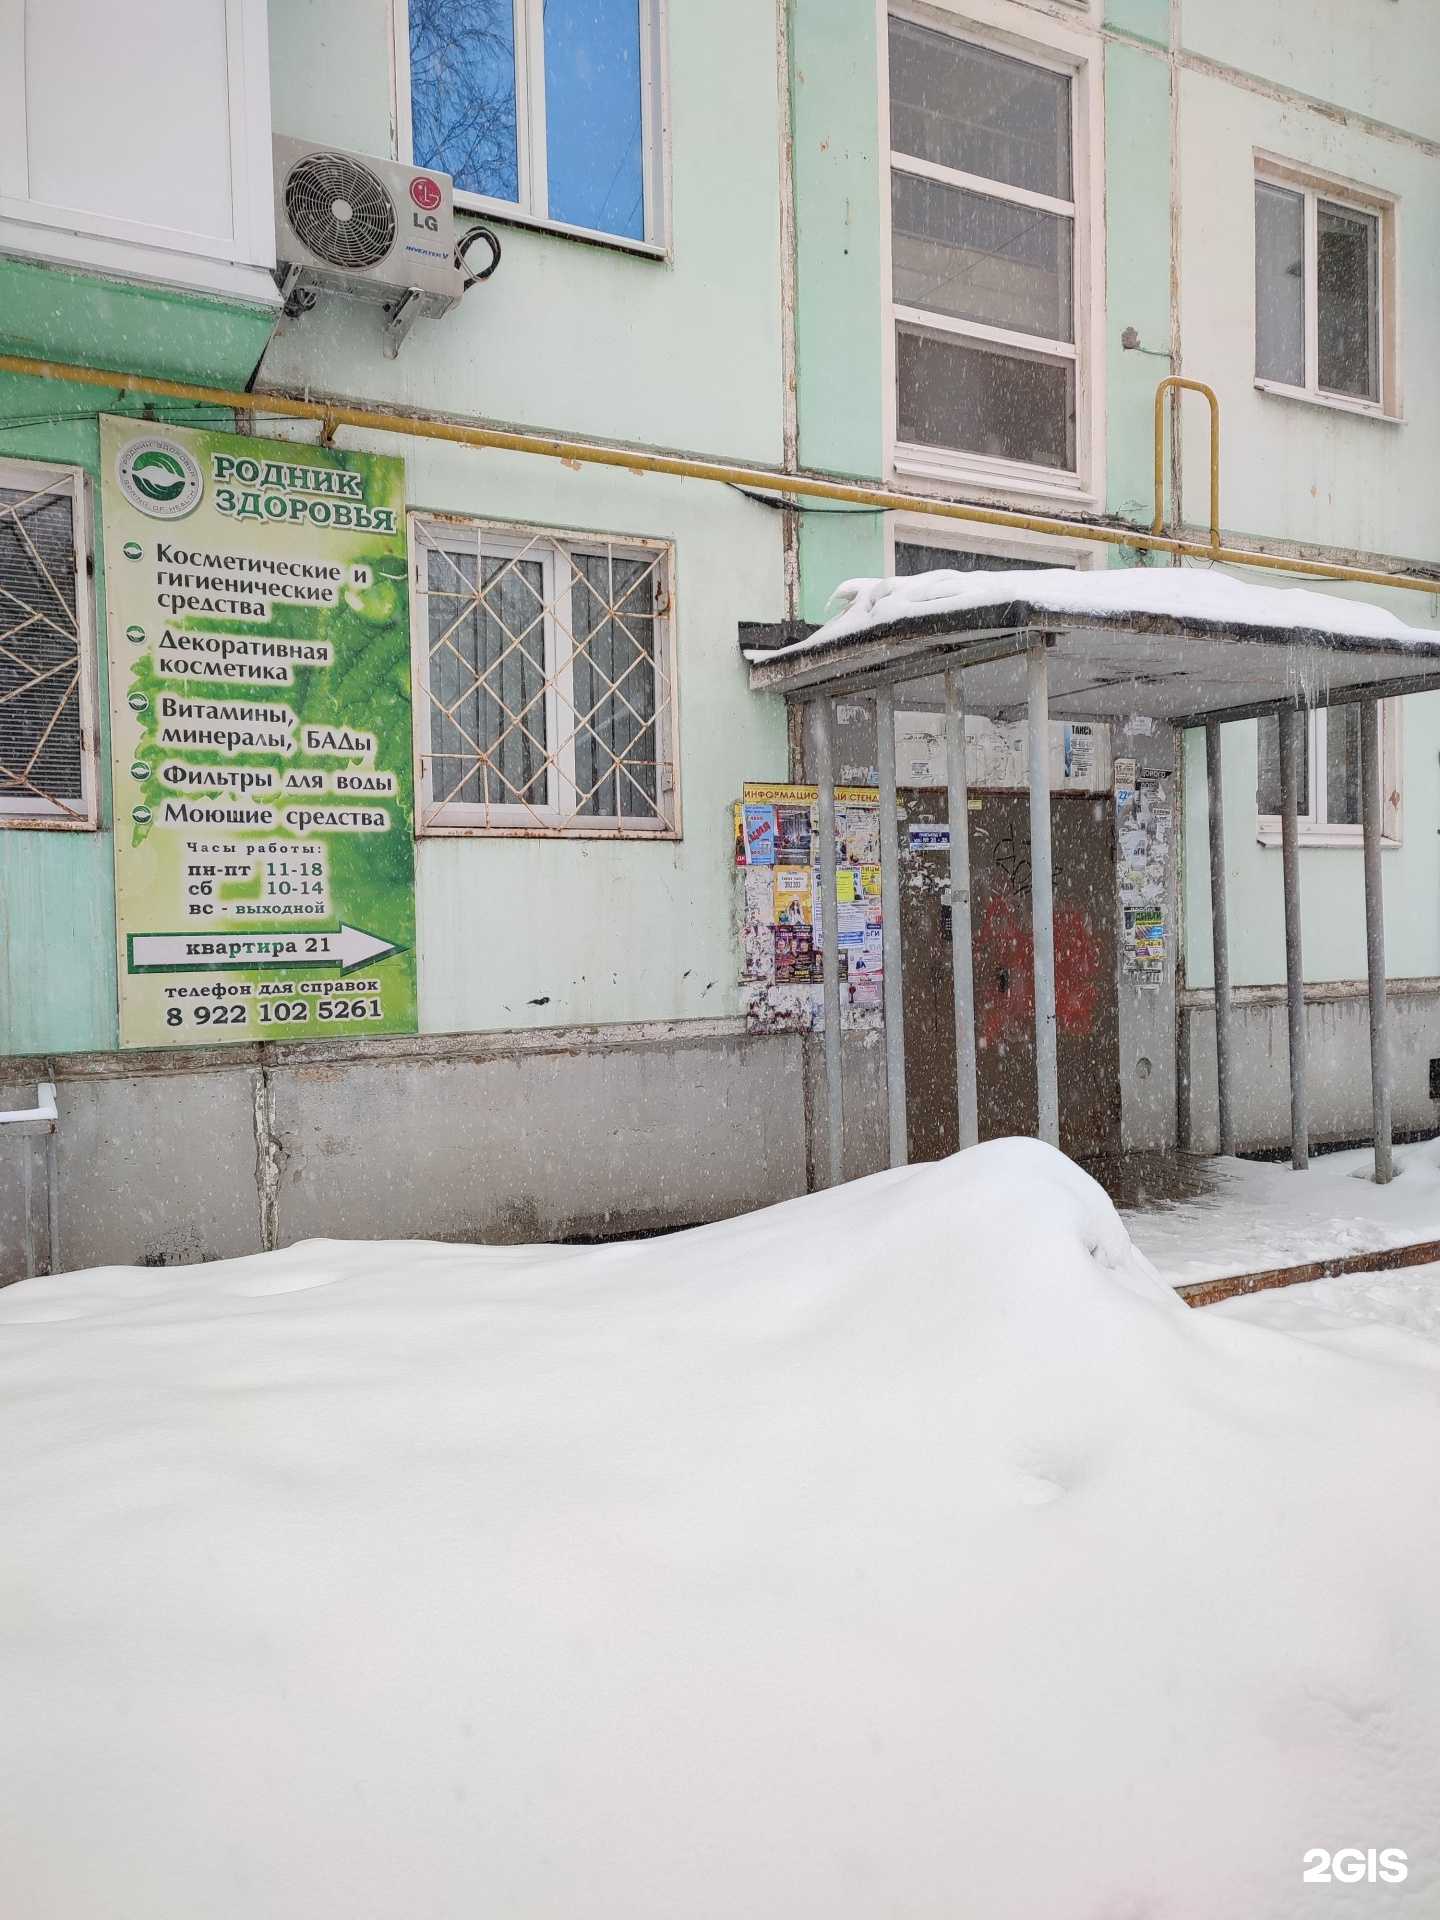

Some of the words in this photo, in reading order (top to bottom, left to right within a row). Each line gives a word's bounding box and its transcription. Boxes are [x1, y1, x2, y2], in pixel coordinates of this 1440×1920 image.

[413, 212, 439, 232] LG
[214, 455, 361, 496] РОДНИК
[216, 489, 394, 531] ЗДОРОВЬЯ
[157, 543, 341, 581] Косметические
[354, 569, 367, 583] и
[157, 571, 333, 601] гигиенические
[158, 592, 265, 616] средства
[159, 630, 328, 661] Декоративная
[160, 658, 288, 681] косметика
[162, 698, 294, 727] Витамины,
[162, 728, 292, 751] минералы,
[307, 730, 371, 751] БАДы
[163, 765, 272, 792] Фильтры
[286, 775, 323, 788] для
[337, 776, 392, 790] воды
[286, 809, 385, 830] средства
[187, 842, 236, 853] Часы
[246, 843, 322, 855] работы:
[187, 864, 251, 876] пн-пт
[266, 862, 323, 876] 11-18
[188, 880, 213, 896] сб
[267, 881, 324, 895] 10-14
[189, 903, 214, 915] вс
[236, 902, 325, 914] выходной
[186, 942, 297, 958] квартира
[304, 937, 331, 952] 21
[164, 983, 251, 999] телефон
[258, 984, 293, 996] для
[300, 980, 379, 995] справок
[166, 1007, 183, 1027] 8
[193, 1004, 247, 1025] 922
[260, 1003, 308, 1022] 102
[318, 1000, 382, 1020] 5261
